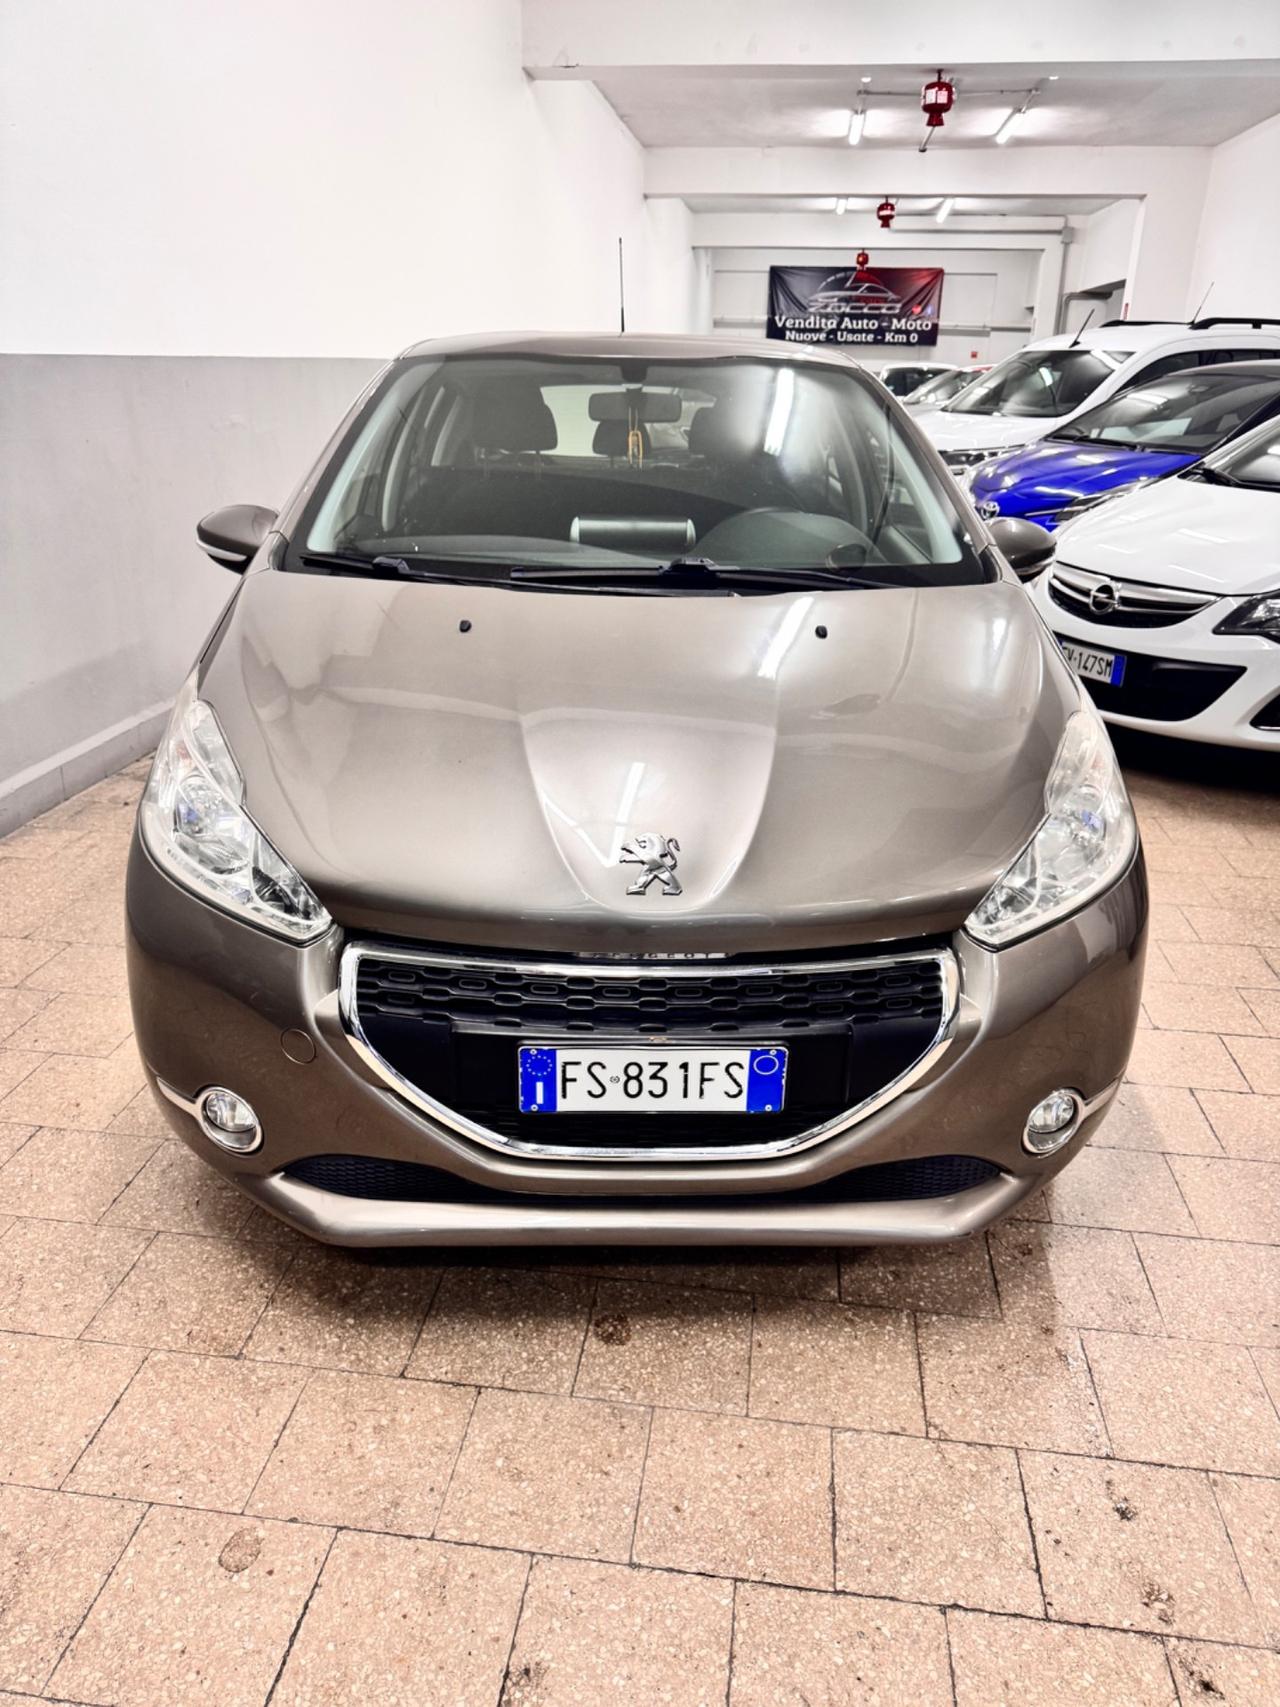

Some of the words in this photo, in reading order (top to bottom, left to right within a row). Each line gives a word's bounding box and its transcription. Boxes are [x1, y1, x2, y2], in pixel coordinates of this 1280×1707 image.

[774, 316, 837, 329] Vendita
[841, 317, 878, 329] Auto
[891, 318, 932, 331] Moto
[785, 331, 826, 341] Nuove
[837, 331, 874, 342] Usate
[884, 332, 907, 343] Km
